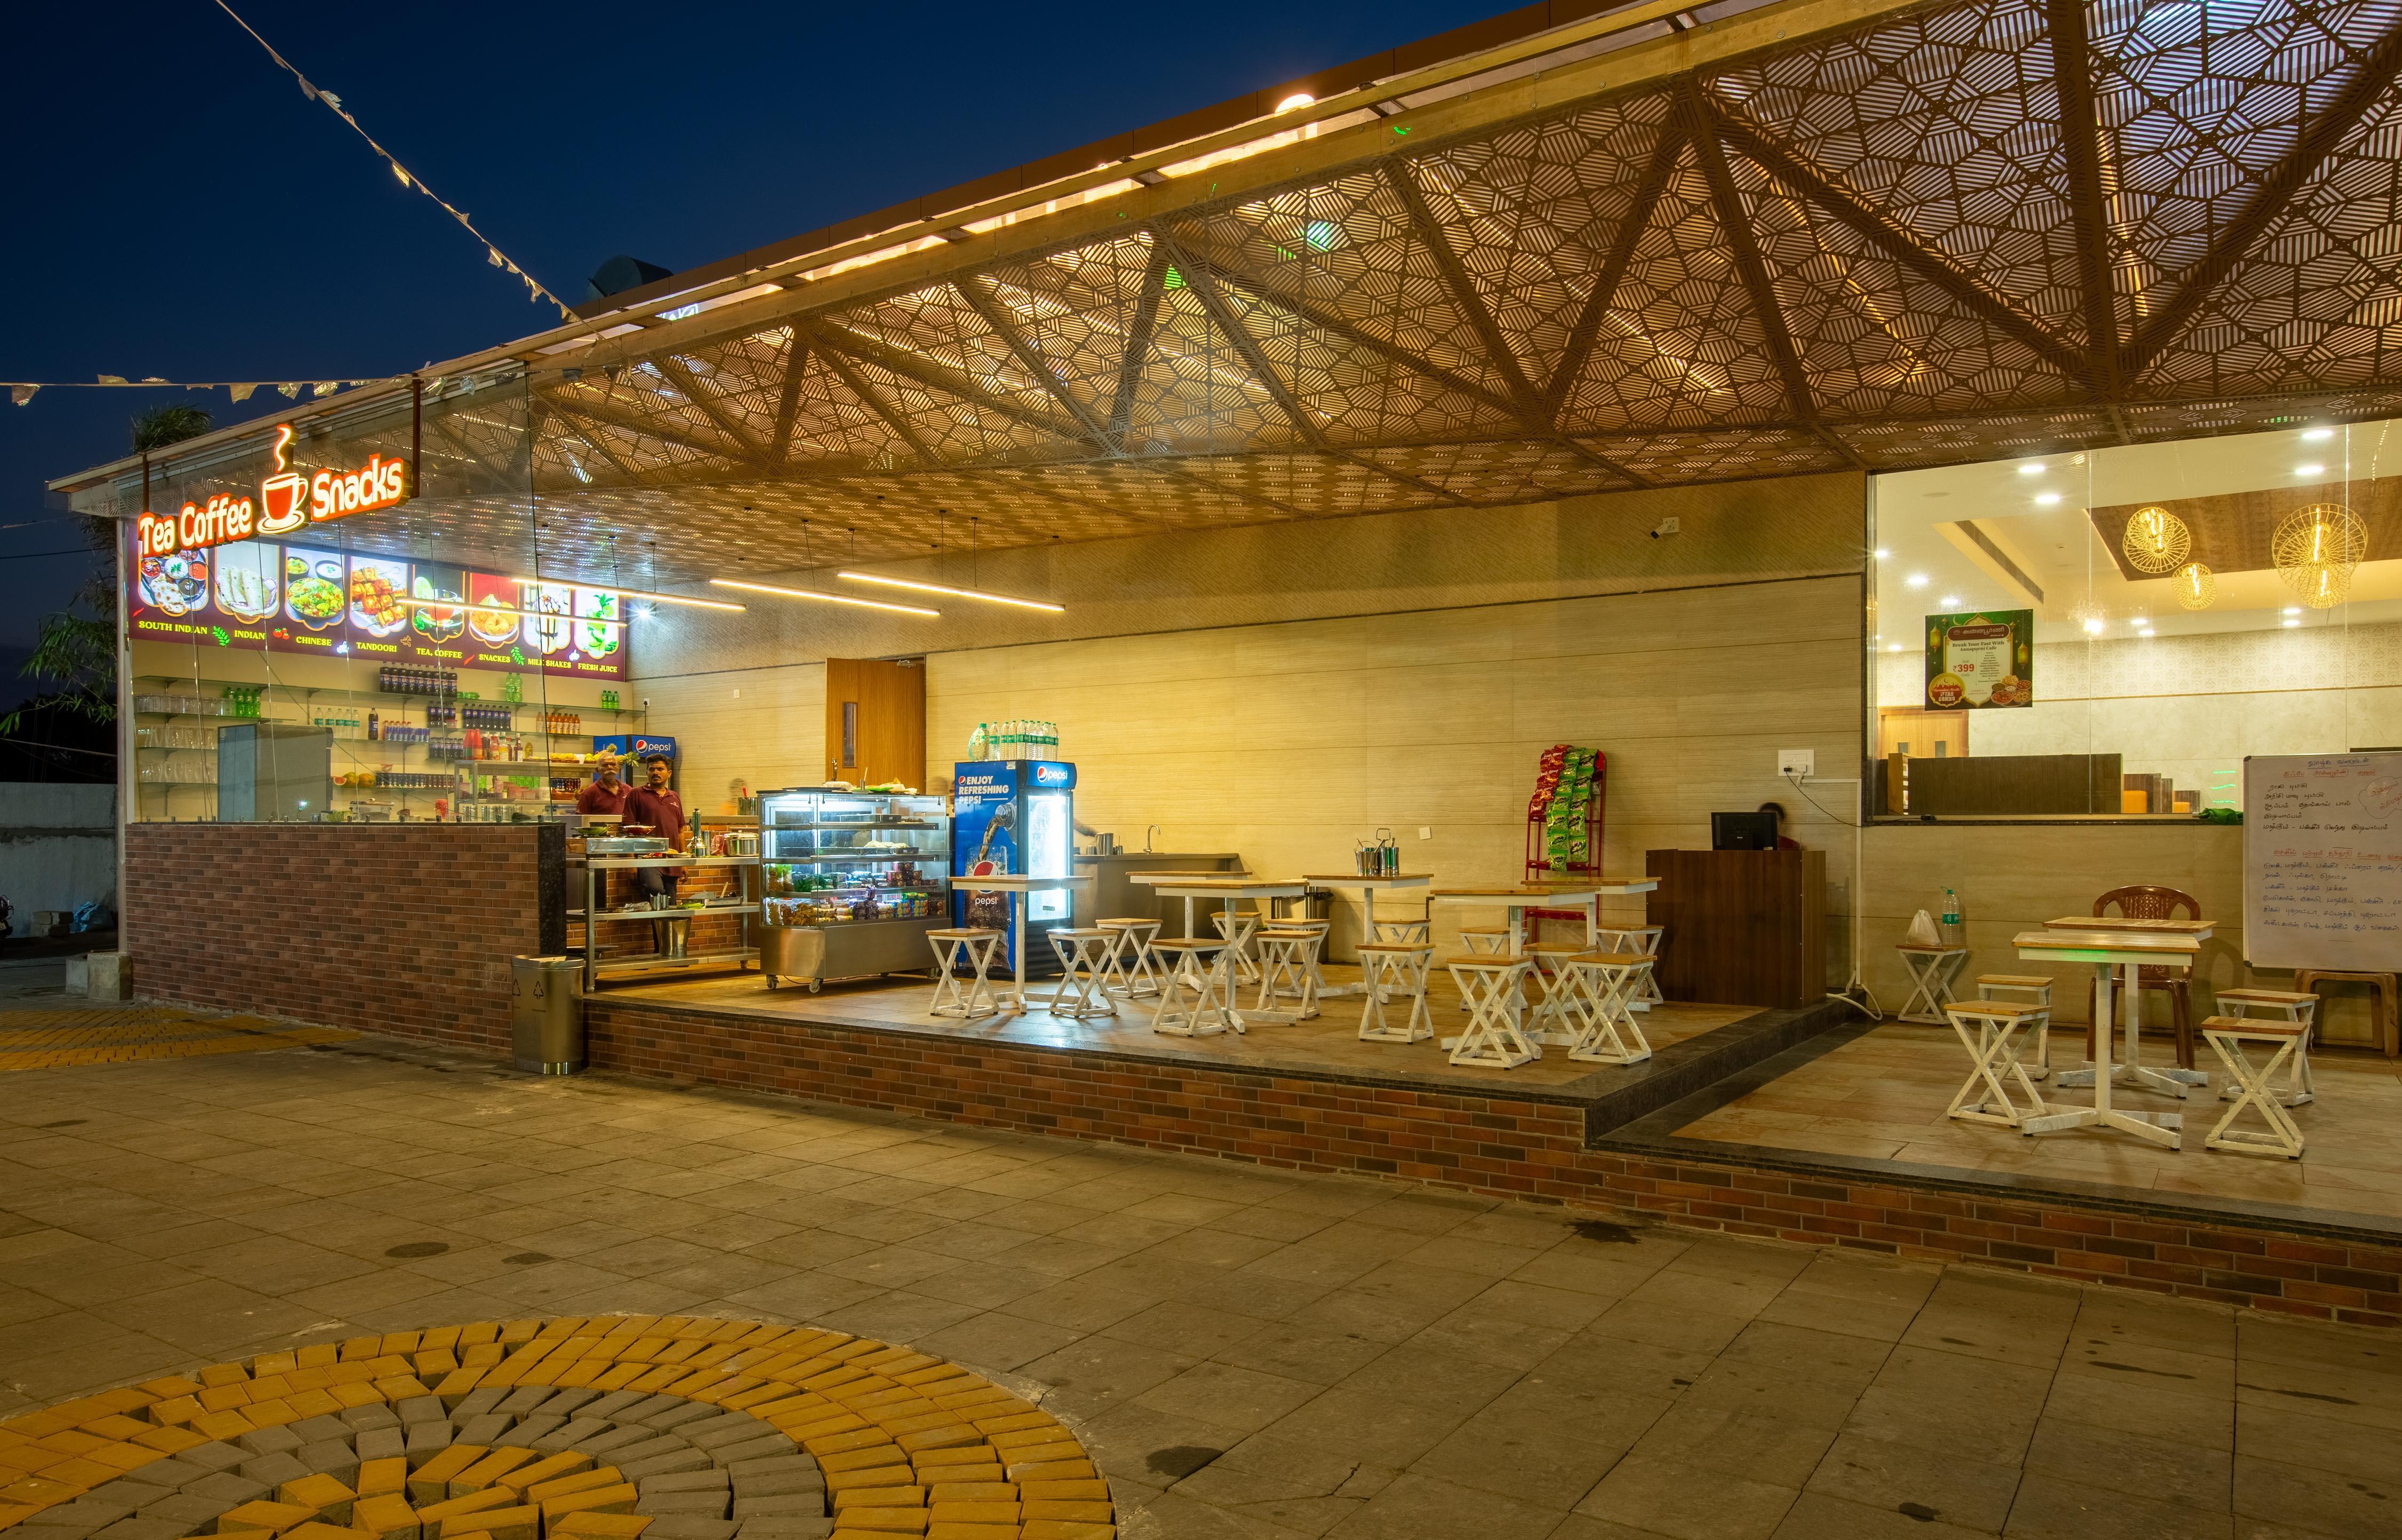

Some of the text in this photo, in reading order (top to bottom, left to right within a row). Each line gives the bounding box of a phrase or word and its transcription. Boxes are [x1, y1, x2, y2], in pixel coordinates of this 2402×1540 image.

[311, 456, 403, 518] Snacks
[139, 497, 252, 555] Tea Coffee
[139, 620, 208, 635] SOUTH INDAN
[1963, 627, 2004, 635] அன்னபூர்ணி
[234, 630, 265, 640] INDIAN
[296, 636, 332, 646] CHINESE
[356, 642, 397, 653] TANDOORI
[416, 647, 462, 659] TEA, COFFEE
[478, 653, 511, 664] SNACKES
[546, 659, 572, 669] SHAKES
[578, 662, 618, 673] FRESH JUICE
[648, 743, 671, 753] pepsi
[1048, 769, 1068, 781] pepsi
[967, 776, 994, 786] ENJOY
[959, 785, 1009, 795] REFRESHING
[959, 795, 981, 804] PEPSI
[2264, 812, 2302, 820] இடியாப்பம்
[2351, 824, 2388, 833] இடியாப்பம்
[975, 897, 997, 906] pepsi
